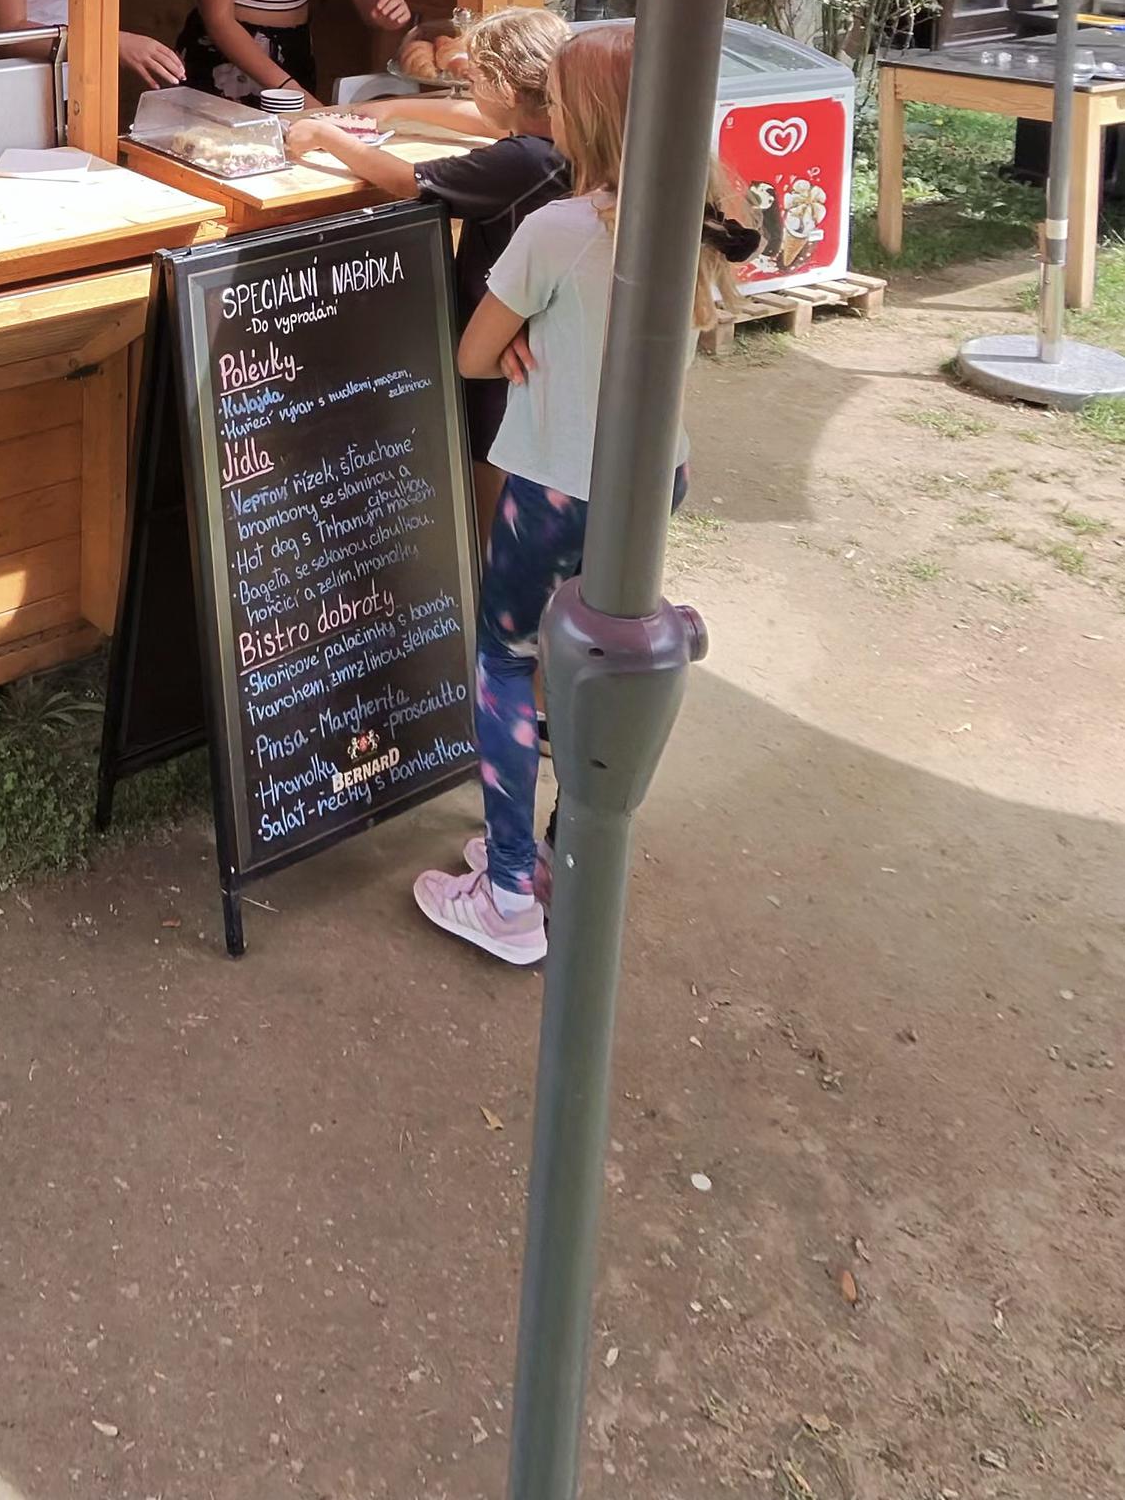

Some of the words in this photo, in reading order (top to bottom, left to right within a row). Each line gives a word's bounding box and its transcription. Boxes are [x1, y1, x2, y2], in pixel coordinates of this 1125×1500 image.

[332, 251, 404, 295] NABÍDKA
[274, 299, 339, 334] vyprodání
[222, 387, 285, 419] Kulajda
[225, 410, 273, 440] Kuřecí
[279, 399, 314, 423] vývar
[318, 396, 325, 407] s
[223, 437, 275, 481] Jídla
[238, 501, 319, 541] brambory
[320, 493, 337, 509] se
[338, 470, 395, 501] slaninou
[399, 464, 412, 477] a
[368, 477, 429, 508] cibulkou
[236, 542, 264, 576] Hot
[271, 534, 300, 560] dog
[302, 531, 311, 546] s
[387, 486, 436, 514] masem
[295, 563, 311, 579] se
[304, 587, 316, 600] a
[239, 617, 310, 667] Bistro
[317, 578, 395, 634] dobroty
[324, 620, 396, 670] palačinky
[398, 613, 407, 627] s
[255, 727, 309, 769] Pinsa
[259, 752, 340, 810] Hranolky
[332, 747, 400, 794] BERNARD
[375, 777, 385, 790] s
